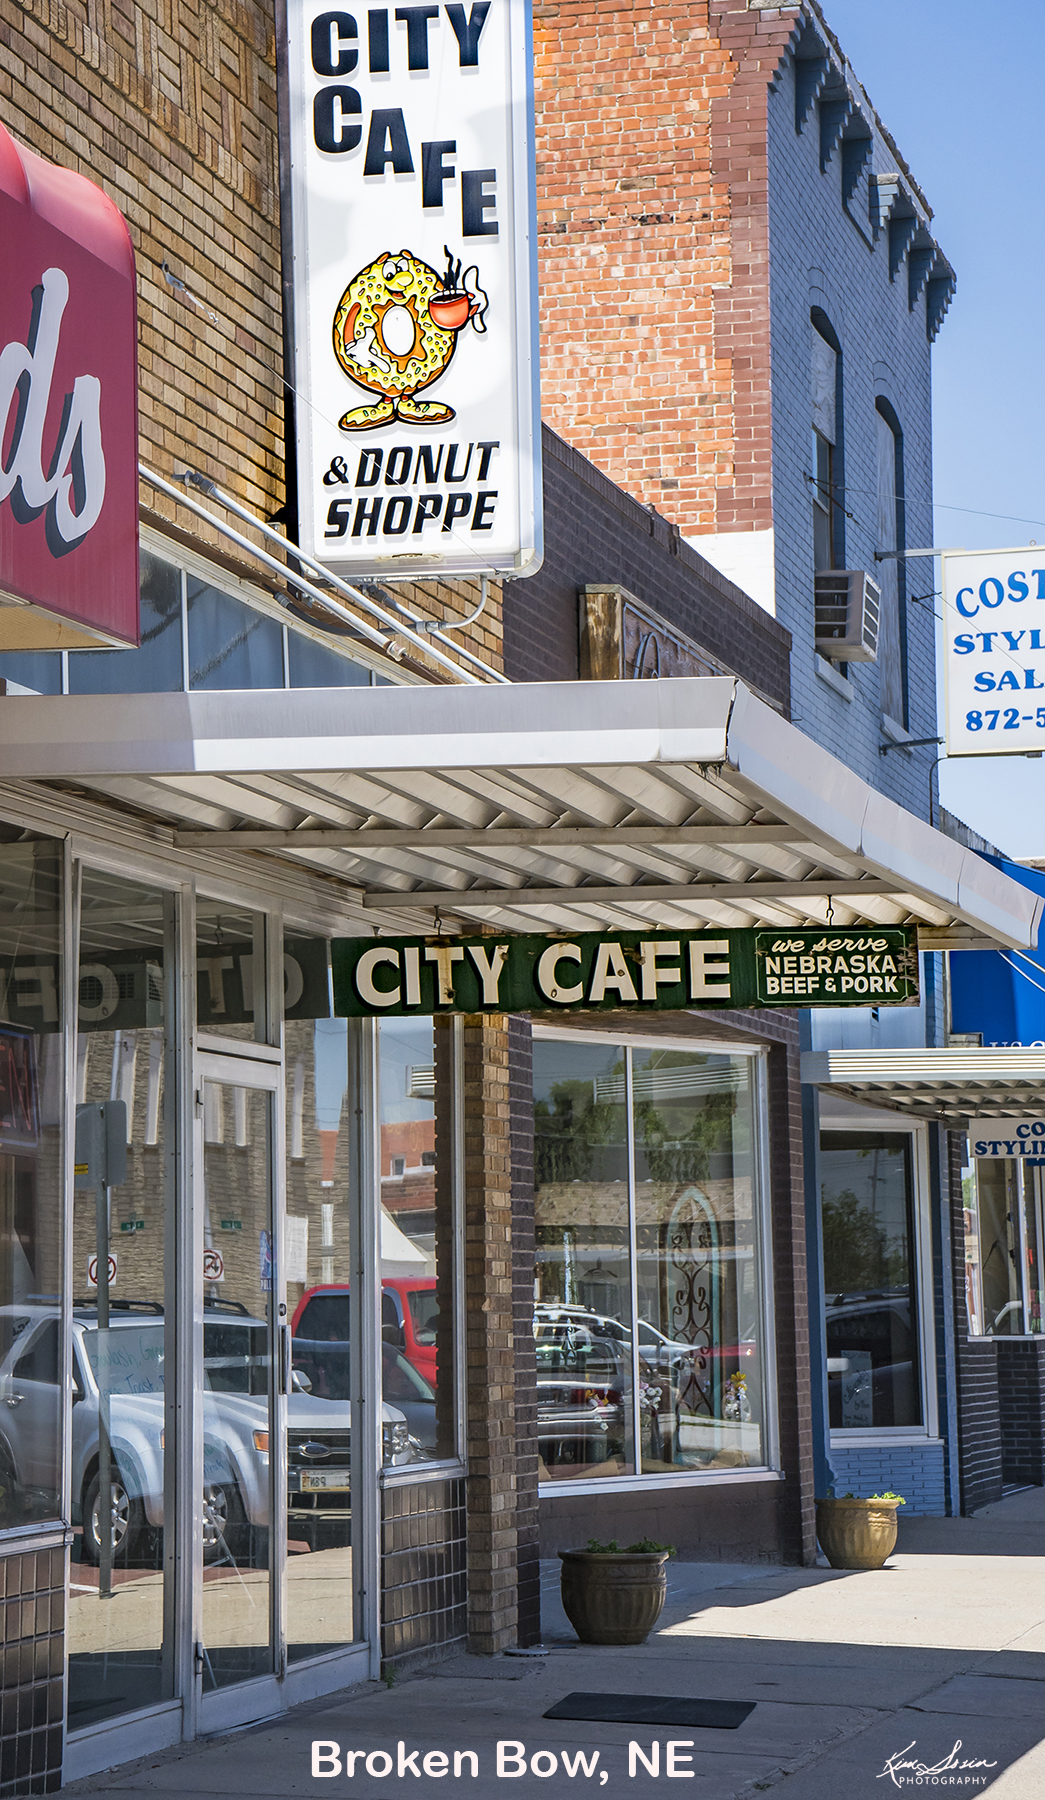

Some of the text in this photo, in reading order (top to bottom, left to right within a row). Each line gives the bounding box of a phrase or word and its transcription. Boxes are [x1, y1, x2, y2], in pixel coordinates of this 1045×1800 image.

[311, 1, 492, 77] CITY
[313, 84, 499, 237] CAFE
[322, 440, 500, 488] & DONUT
[324, 490, 498, 538] SHOPPE
[765, 954, 898, 975] NEBRASKA
[771, 937, 889, 953] we serve
[355, 944, 510, 1007] CITY
[537, 939, 732, 1004] CAFE
[766, 976, 899, 995] BEEF & PORK
